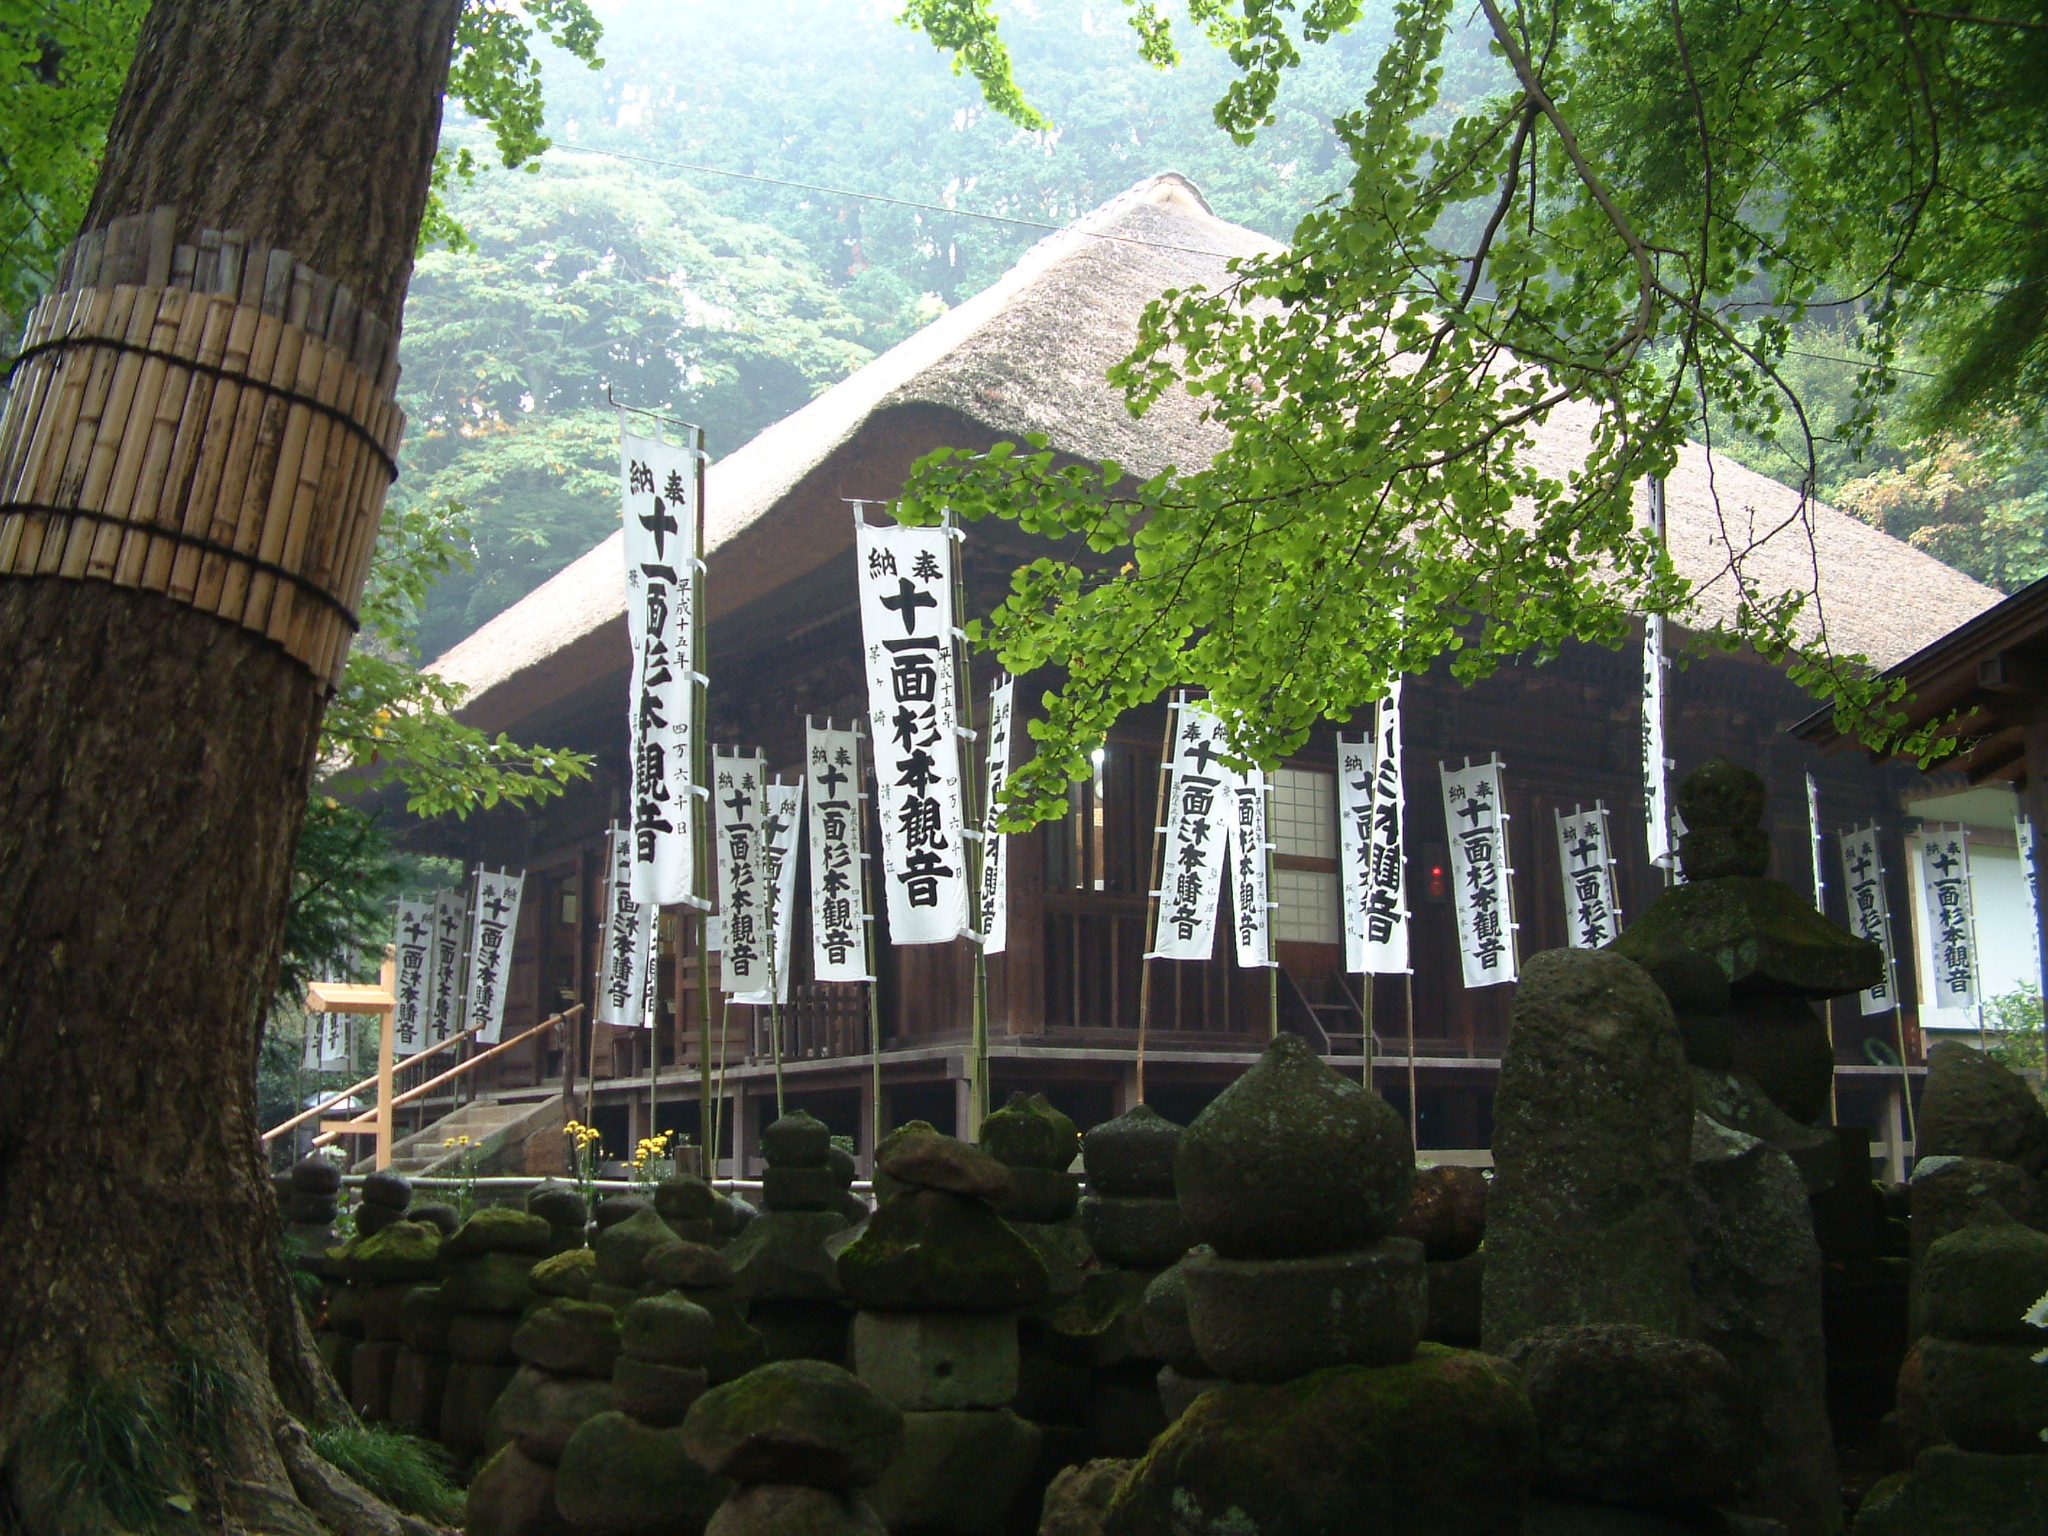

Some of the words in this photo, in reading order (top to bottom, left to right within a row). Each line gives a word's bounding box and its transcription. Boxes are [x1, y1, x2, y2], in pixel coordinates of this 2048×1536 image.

[634, 495, 679, 864] 十一面杉本観音
[674, 578, 692, 669] 平成十五年
[879, 577, 954, 908] 十一面杉本観音
[723, 788, 758, 977] 十一面杉本観音
[816, 764, 855, 965] 十一面杉本観音
[1457, 797, 1506, 970] 十一面杉本観音
[1932, 853, 1972, 994] 十一面杉本観音
